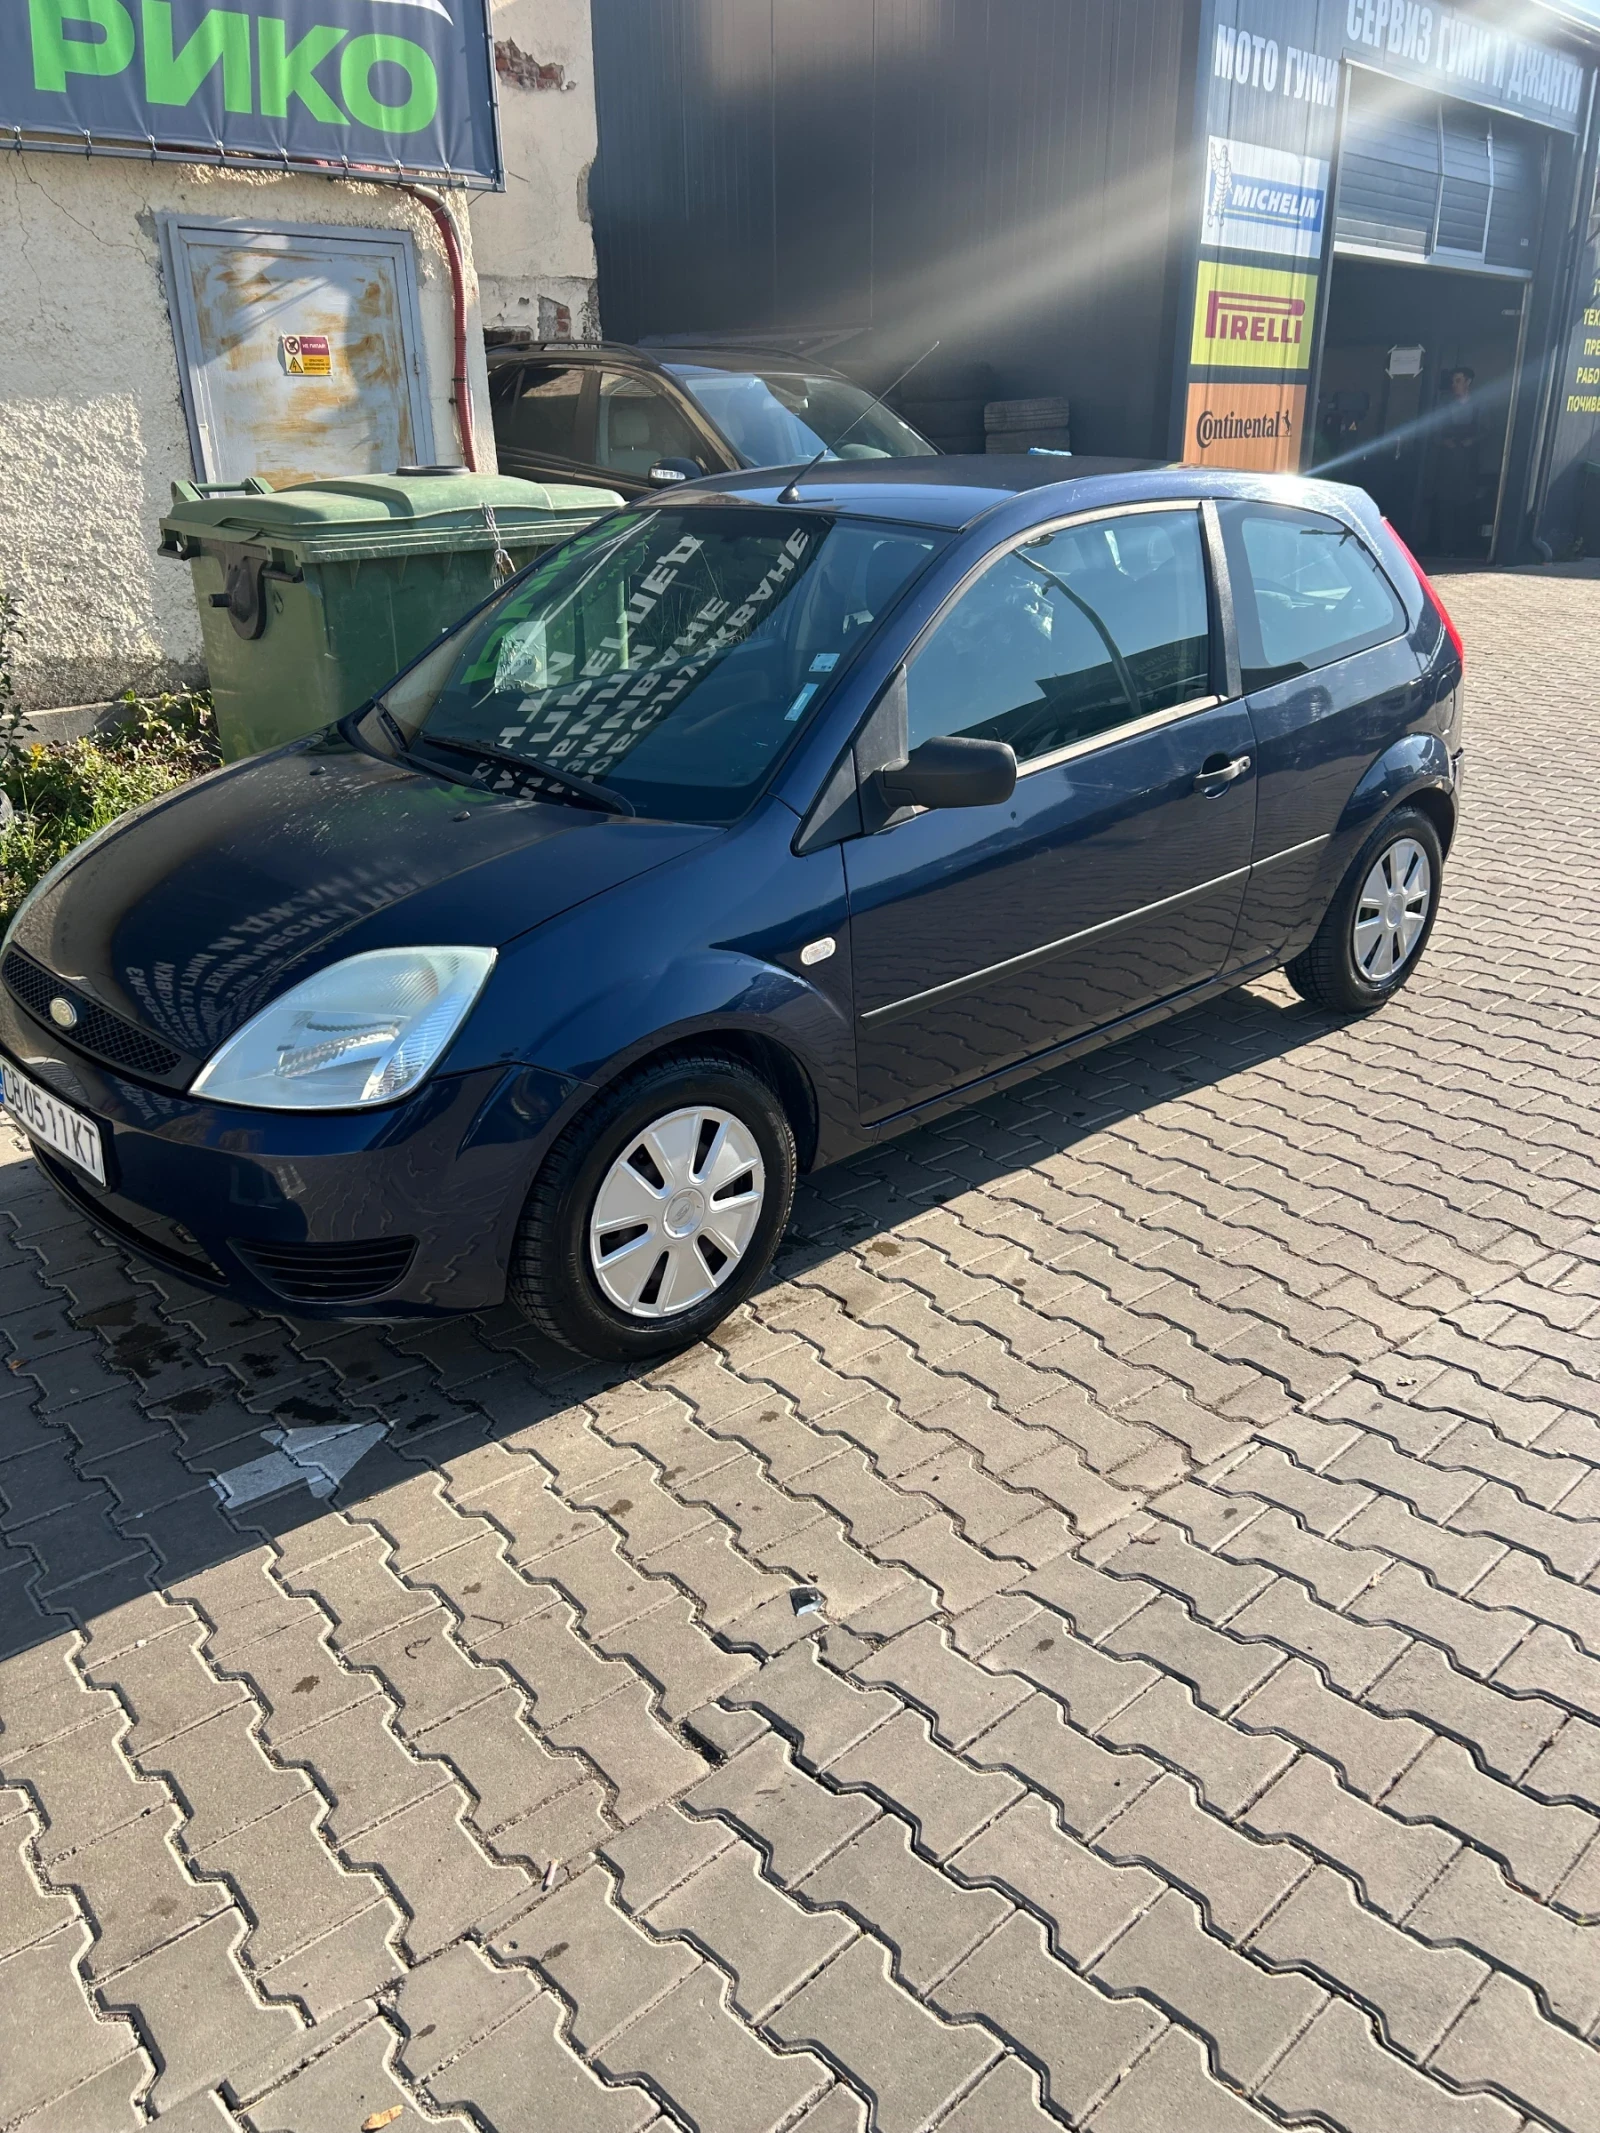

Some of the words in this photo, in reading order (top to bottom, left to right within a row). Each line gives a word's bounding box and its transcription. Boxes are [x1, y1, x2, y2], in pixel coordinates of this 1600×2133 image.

[28, 0, 438, 133] РИКО
[1214, 24, 1278, 92] МОТО
[1283, 46, 1339, 108] ГУМИ
[1346, 0, 1433, 64] СЕРВИЗ
[1435, 16, 1491, 84] ГУМИ
[1507, 42, 1584, 115] ДЖАНТИ
[1231, 184, 1320, 219] MICHELIN
[1204, 290, 1306, 344] PIRELLI
[1196, 409, 1281, 449] Continental
